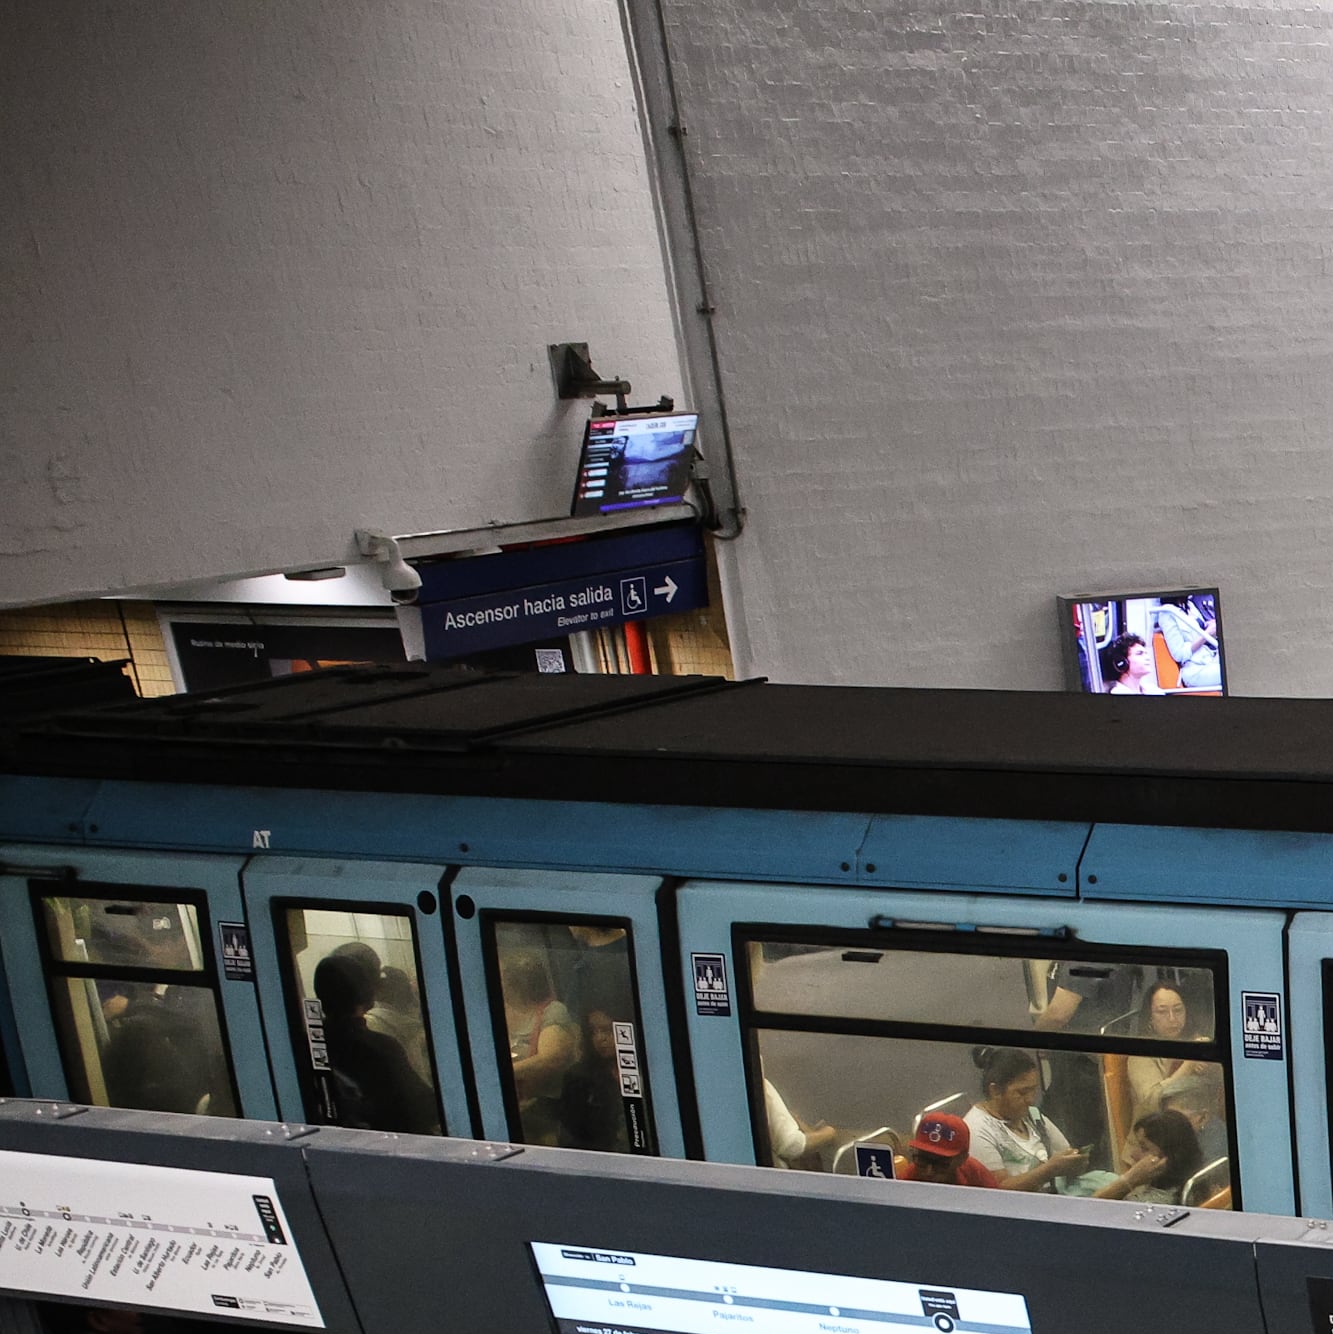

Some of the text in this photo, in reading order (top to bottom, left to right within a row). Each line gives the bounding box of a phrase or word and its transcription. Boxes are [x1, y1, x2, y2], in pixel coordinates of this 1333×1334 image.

[445, 585, 613, 631] Ascensor hacia salida
[557, 612, 589, 628] Elevator
[591, 611, 599, 620] to
[253, 830, 271, 848] AT
[1244, 1034, 1281, 1043] DEJE BAJAR
[630, 1103, 641, 1148] Precaución
[595, 1254, 611, 1263] San
[611, 1256, 634, 1266] Pablo
[607, 1298, 652, 1312] Las Rejas
[712, 1309, 754, 1323] Pajaritos
[818, 1322, 860, 1334] Neptuno
